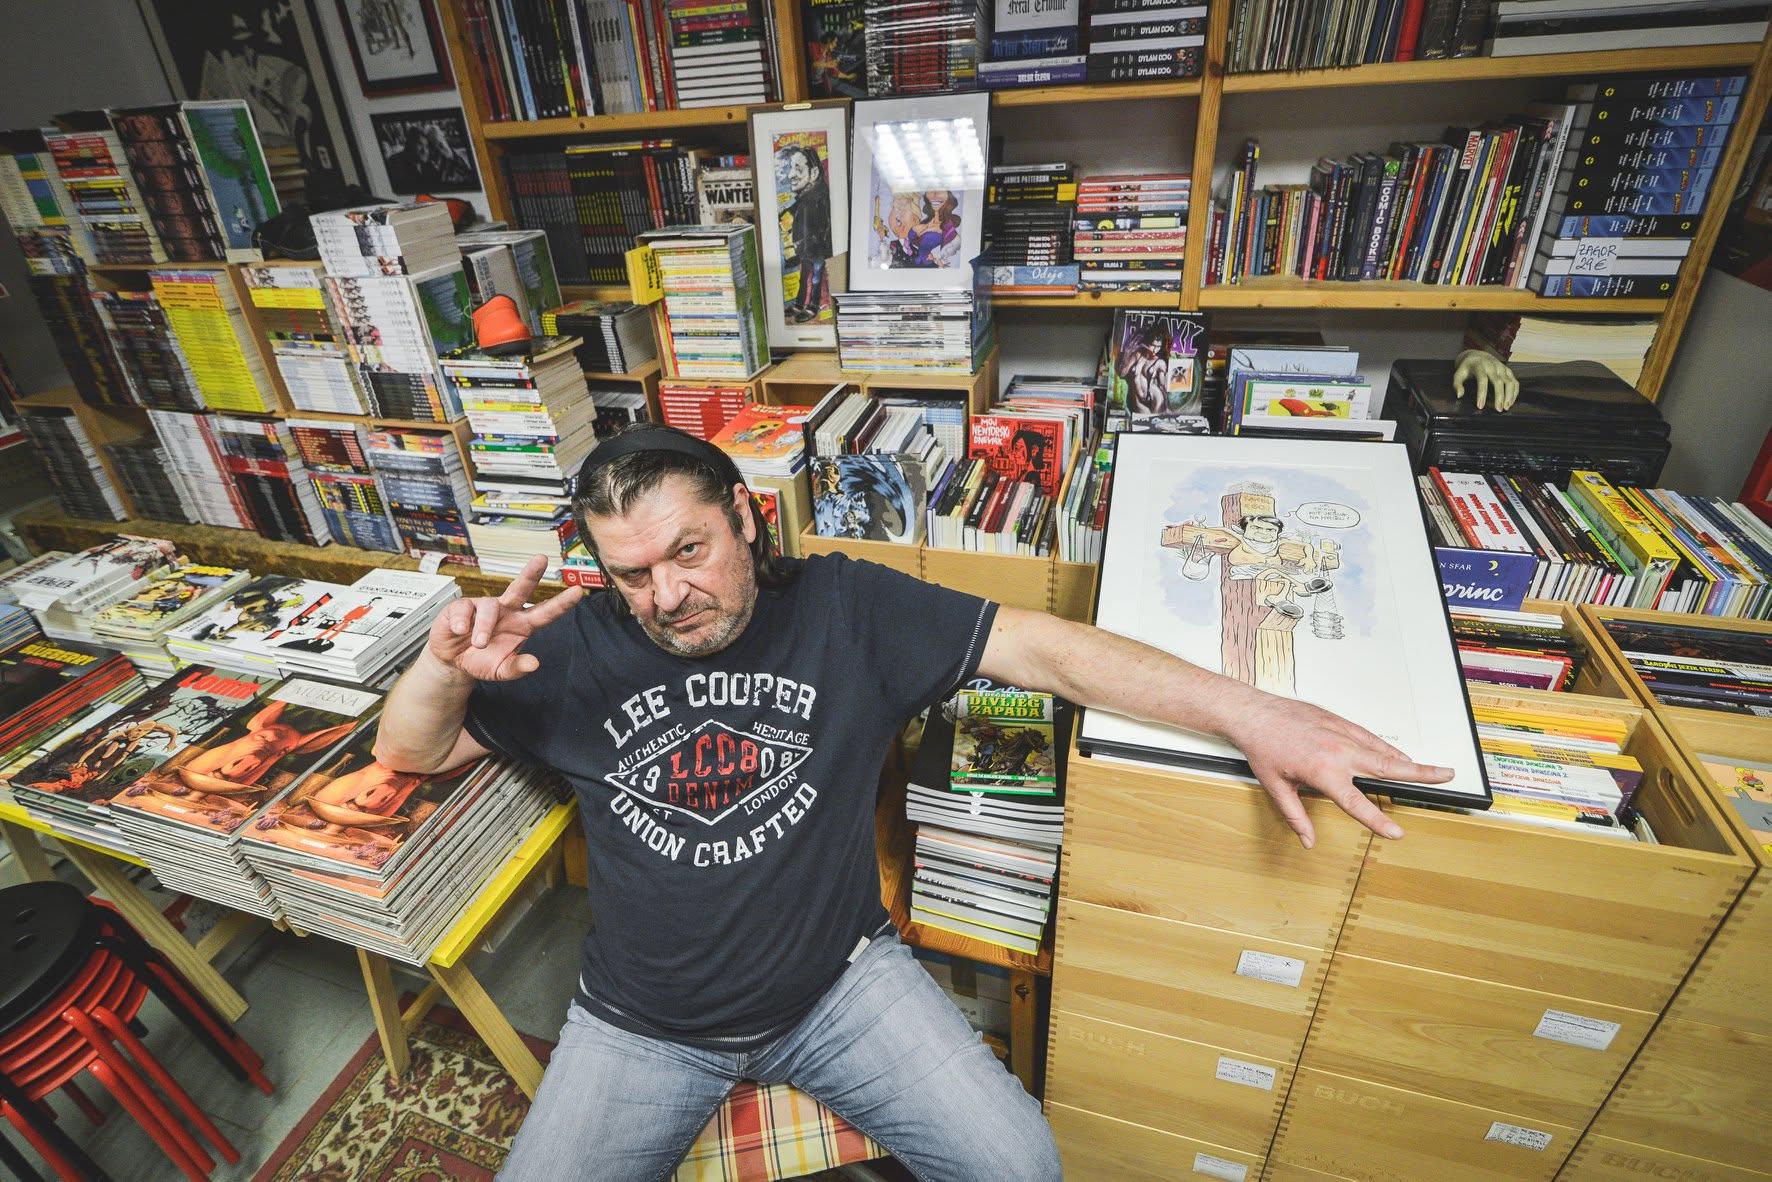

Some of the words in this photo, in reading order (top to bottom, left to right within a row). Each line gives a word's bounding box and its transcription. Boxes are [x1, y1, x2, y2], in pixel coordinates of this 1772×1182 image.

[1140, 27, 1160, 35] DYLAN
[1161, 25, 1175, 33] DOG
[1138, 55, 1158, 63] DYLAN
[1158, 54, 1172, 62] DOG
[1137, 68, 1157, 76] DYLAN
[1462, 134, 1480, 165] MARVEL
[1377, 187, 1391, 225] COMIC
[1368, 226, 1382, 256] BOOK
[1578, 244, 1617, 257] ZAGOR
[1120, 313, 1205, 357] HEAVY
[1449, 563, 1472, 571] SFAR
[18, 644, 99, 666] BLUEBERRY
[293, 685, 361, 708] MURENA
[604, 685, 671, 749] LEE
[686, 671, 816, 720] COOPER
[971, 706, 1039, 717] ZAPADA
[752, 722, 810, 745] HERITAGE
[617, 724, 686, 772] AUTHENTIC
[668, 777, 754, 810] DENIM
[743, 771, 799, 815] LONDON
[610, 791, 686, 861] UNION
[694, 782, 818, 868] CRAFTED
